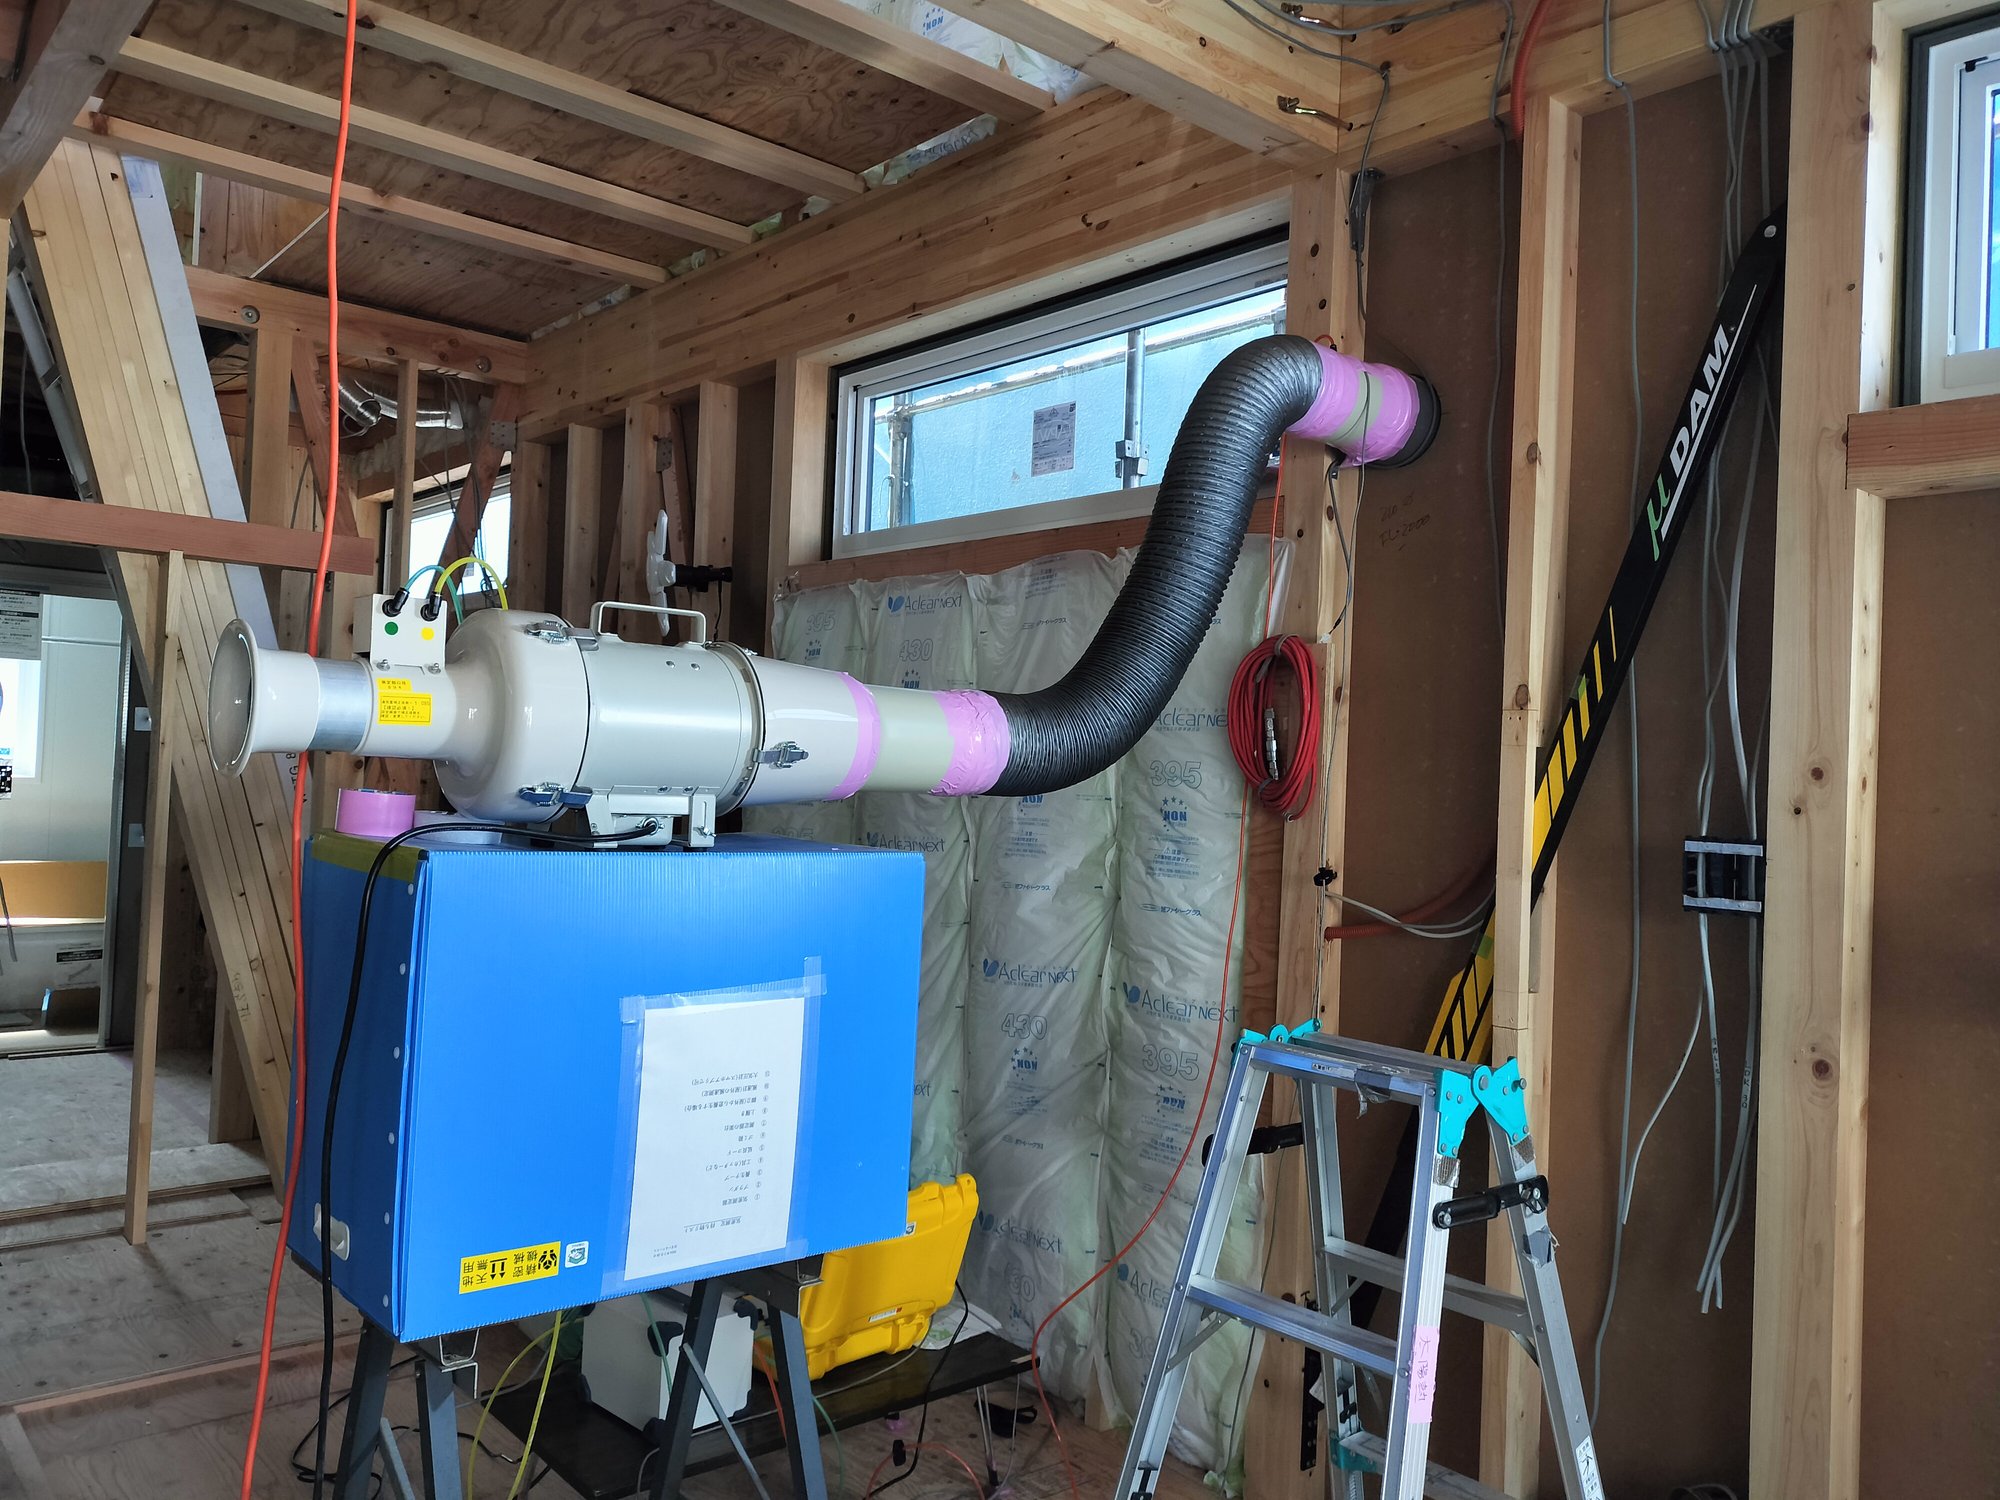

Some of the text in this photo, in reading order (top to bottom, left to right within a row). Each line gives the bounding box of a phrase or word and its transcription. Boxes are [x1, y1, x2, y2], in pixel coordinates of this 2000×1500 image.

[806, 610, 836, 633] 395
[899, 638, 934, 662] 430
[1149, 760, 1203, 790] 395
[1163, 810, 1187, 822] NON
[998, 961, 1078, 984] AclearNext
[1141, 989, 1239, 1023] AclearNext
[1001, 1012, 1048, 1040] 430
[1017, 1058, 1038, 1071] NON
[1142, 1043, 1200, 1081] 395
[463, 1258, 489, 1273] 無用
[513, 1249, 538, 1264] 機械
[462, 1272, 487, 1287] 天地
[512, 1263, 537, 1278] 精密
